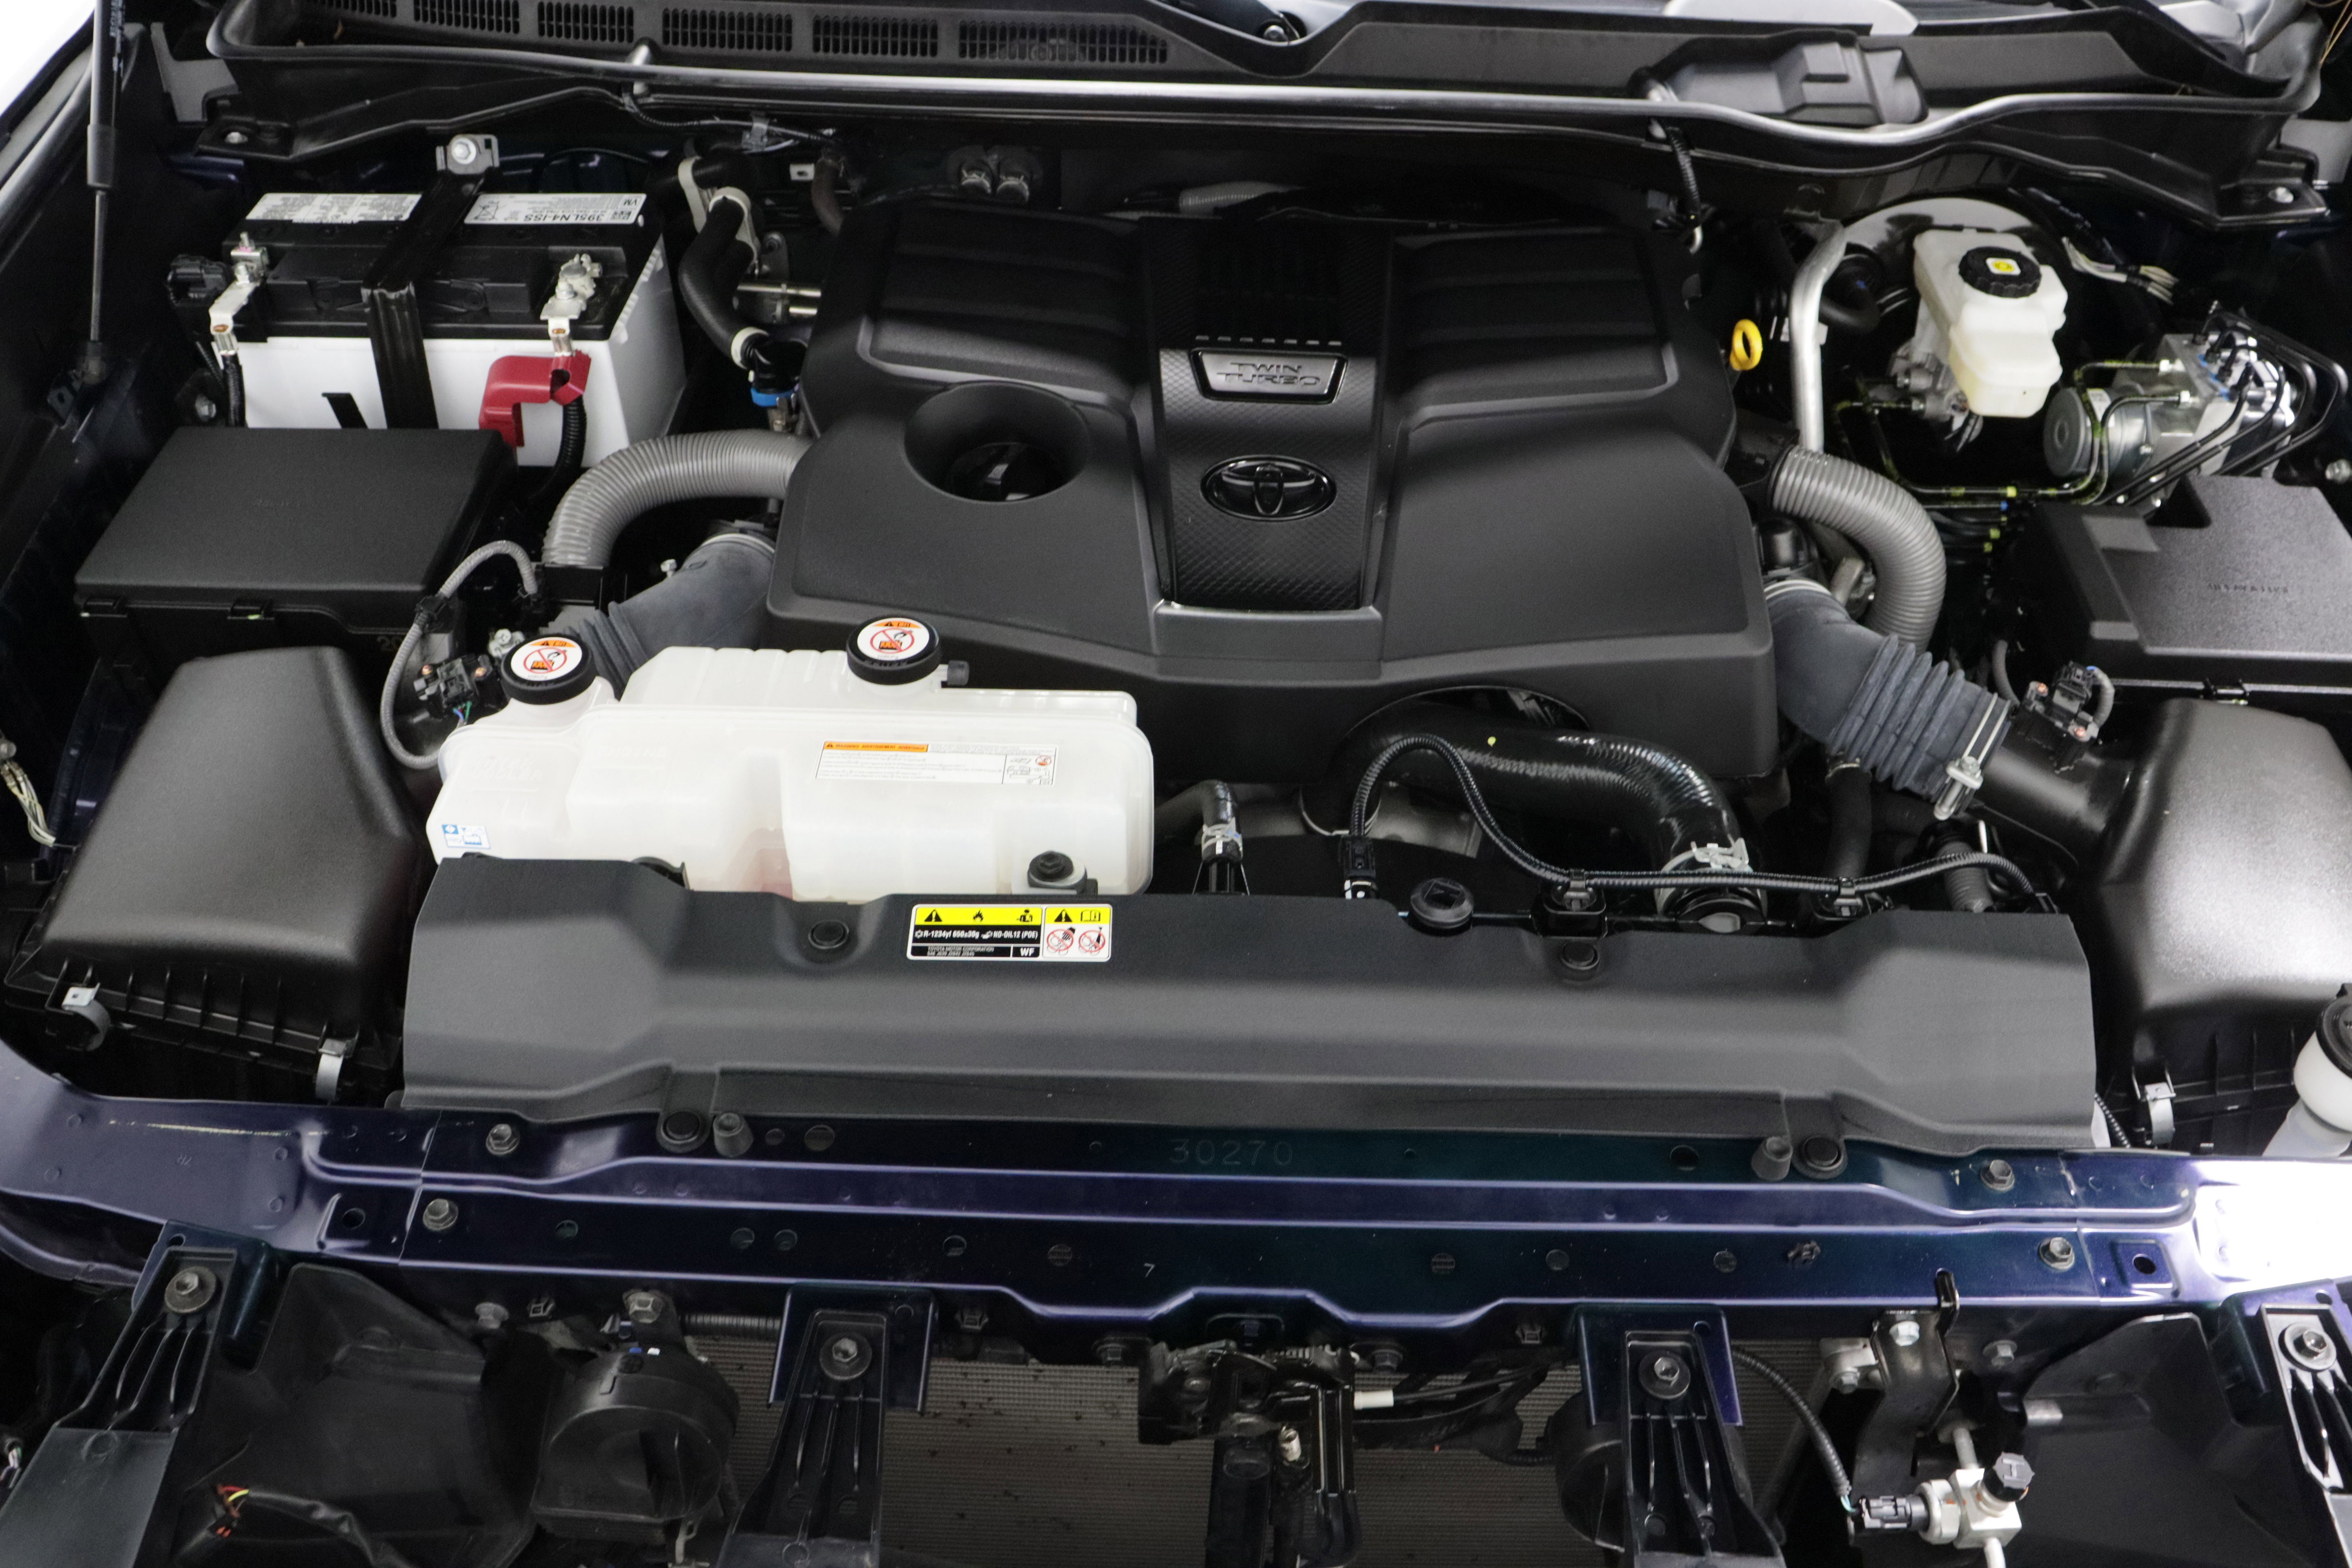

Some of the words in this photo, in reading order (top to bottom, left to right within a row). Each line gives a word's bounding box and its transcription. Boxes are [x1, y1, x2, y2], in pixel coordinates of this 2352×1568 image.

[1230, 362, 1302, 373] TWIN
[1216, 372, 1321, 386] TURBO
[598, 745, 668, 758] ENGINE
[471, 767, 543, 781] COOLER
[923, 930, 952, 939] R-1234yf
[952, 930, 980, 940] 650±30g
[1022, 930, 1038, 940] (POE)
[1020, 947, 1035, 956] WF
[1169, 1138, 1293, 1167] 30270
